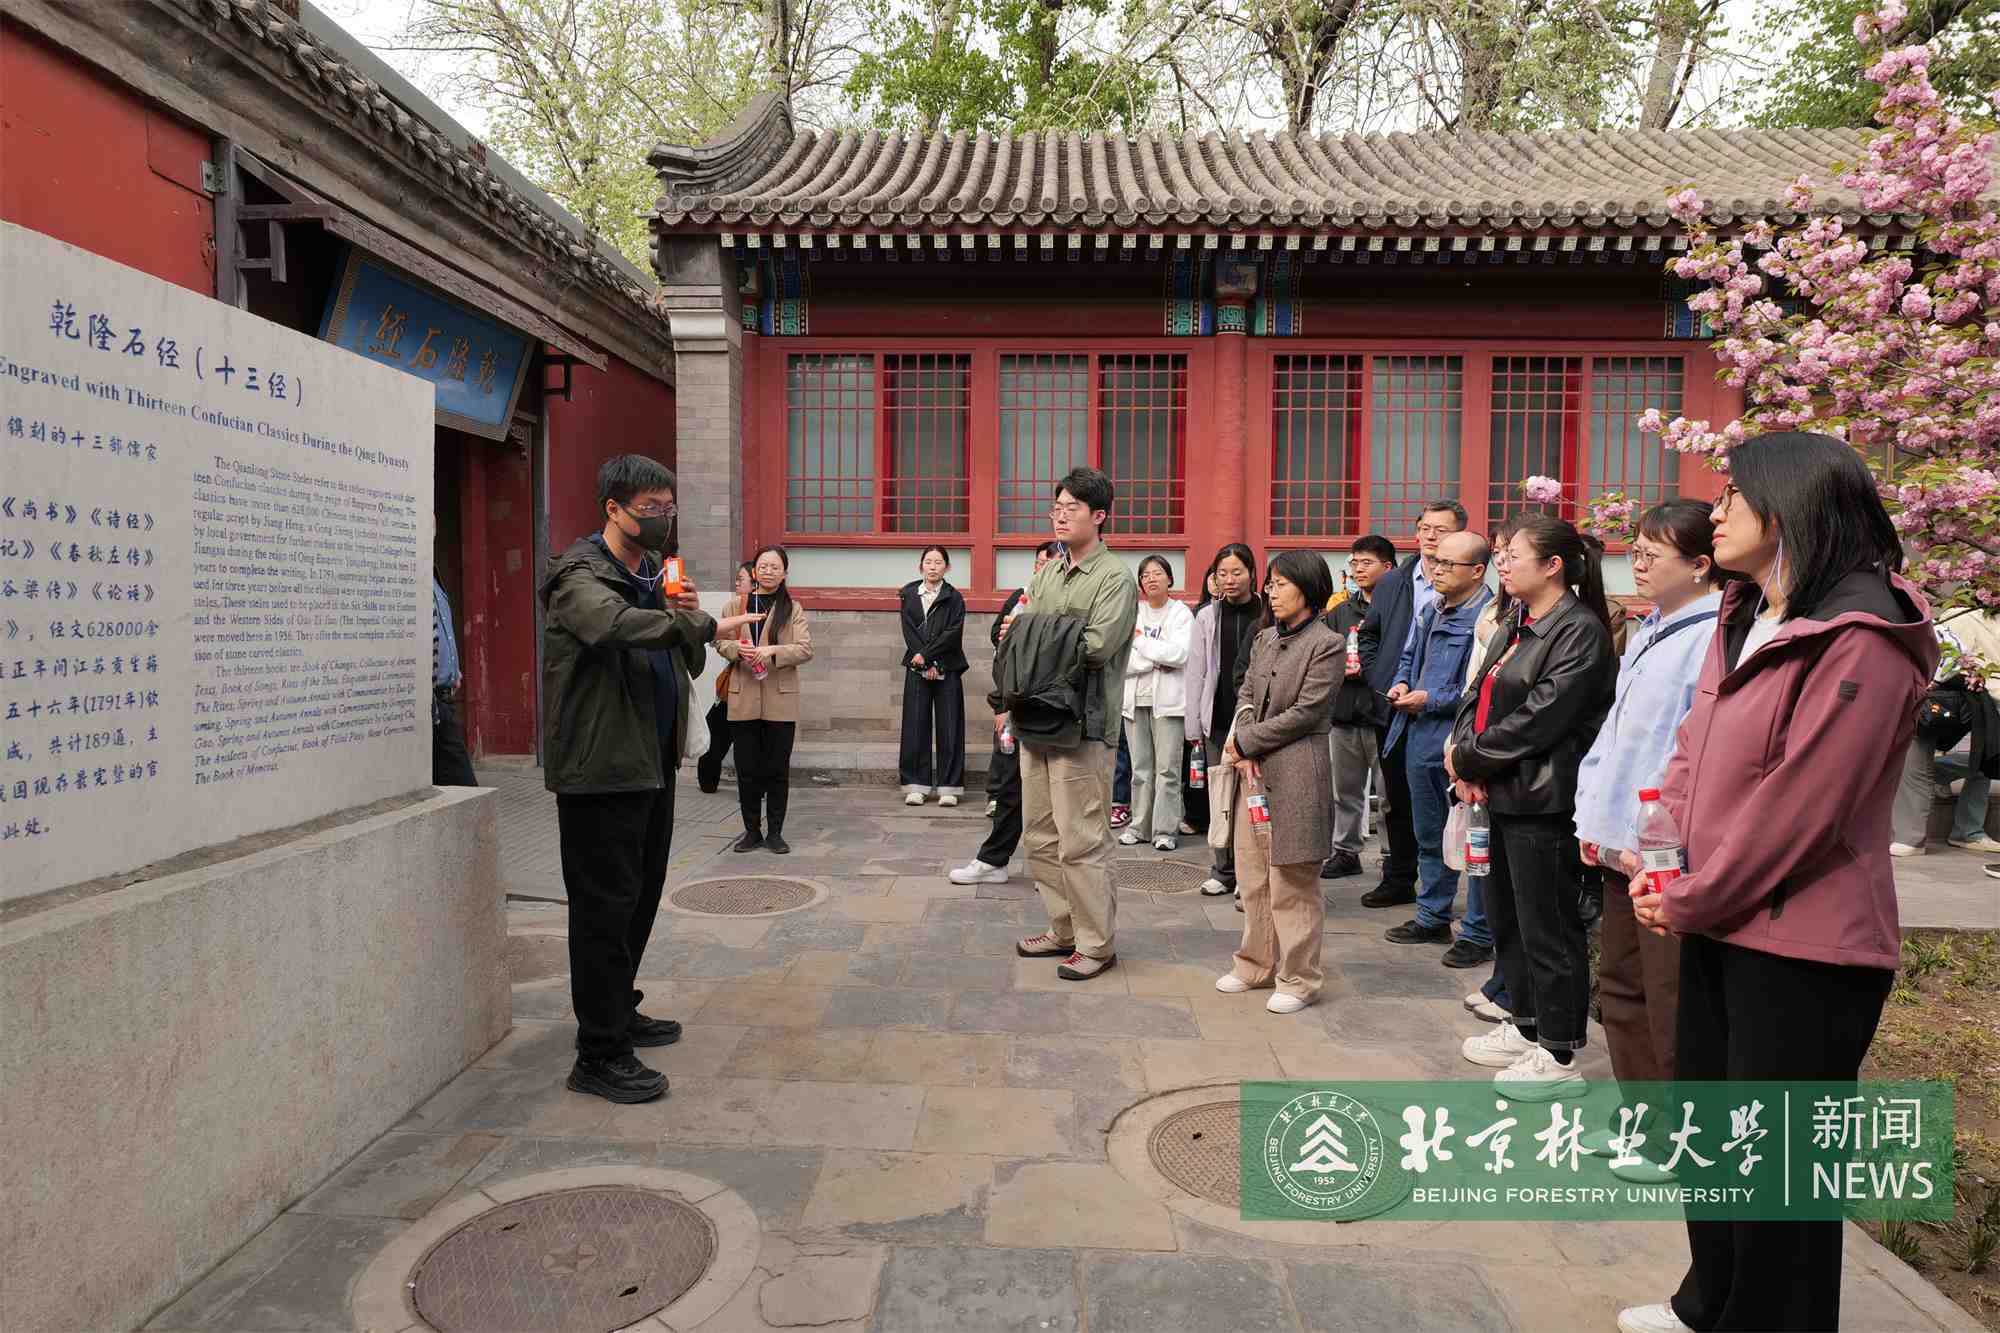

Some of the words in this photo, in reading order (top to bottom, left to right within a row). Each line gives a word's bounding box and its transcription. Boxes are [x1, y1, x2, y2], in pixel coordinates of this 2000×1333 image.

[86, 381, 121, 402] with
[124, 384, 187, 417] Thirteen
[191, 403, 254, 434] Confucian
[257, 421, 299, 444] Classics
[302, 432, 337, 454] During
[338, 441, 353, 457] the
[355, 445, 376, 465] Qing
